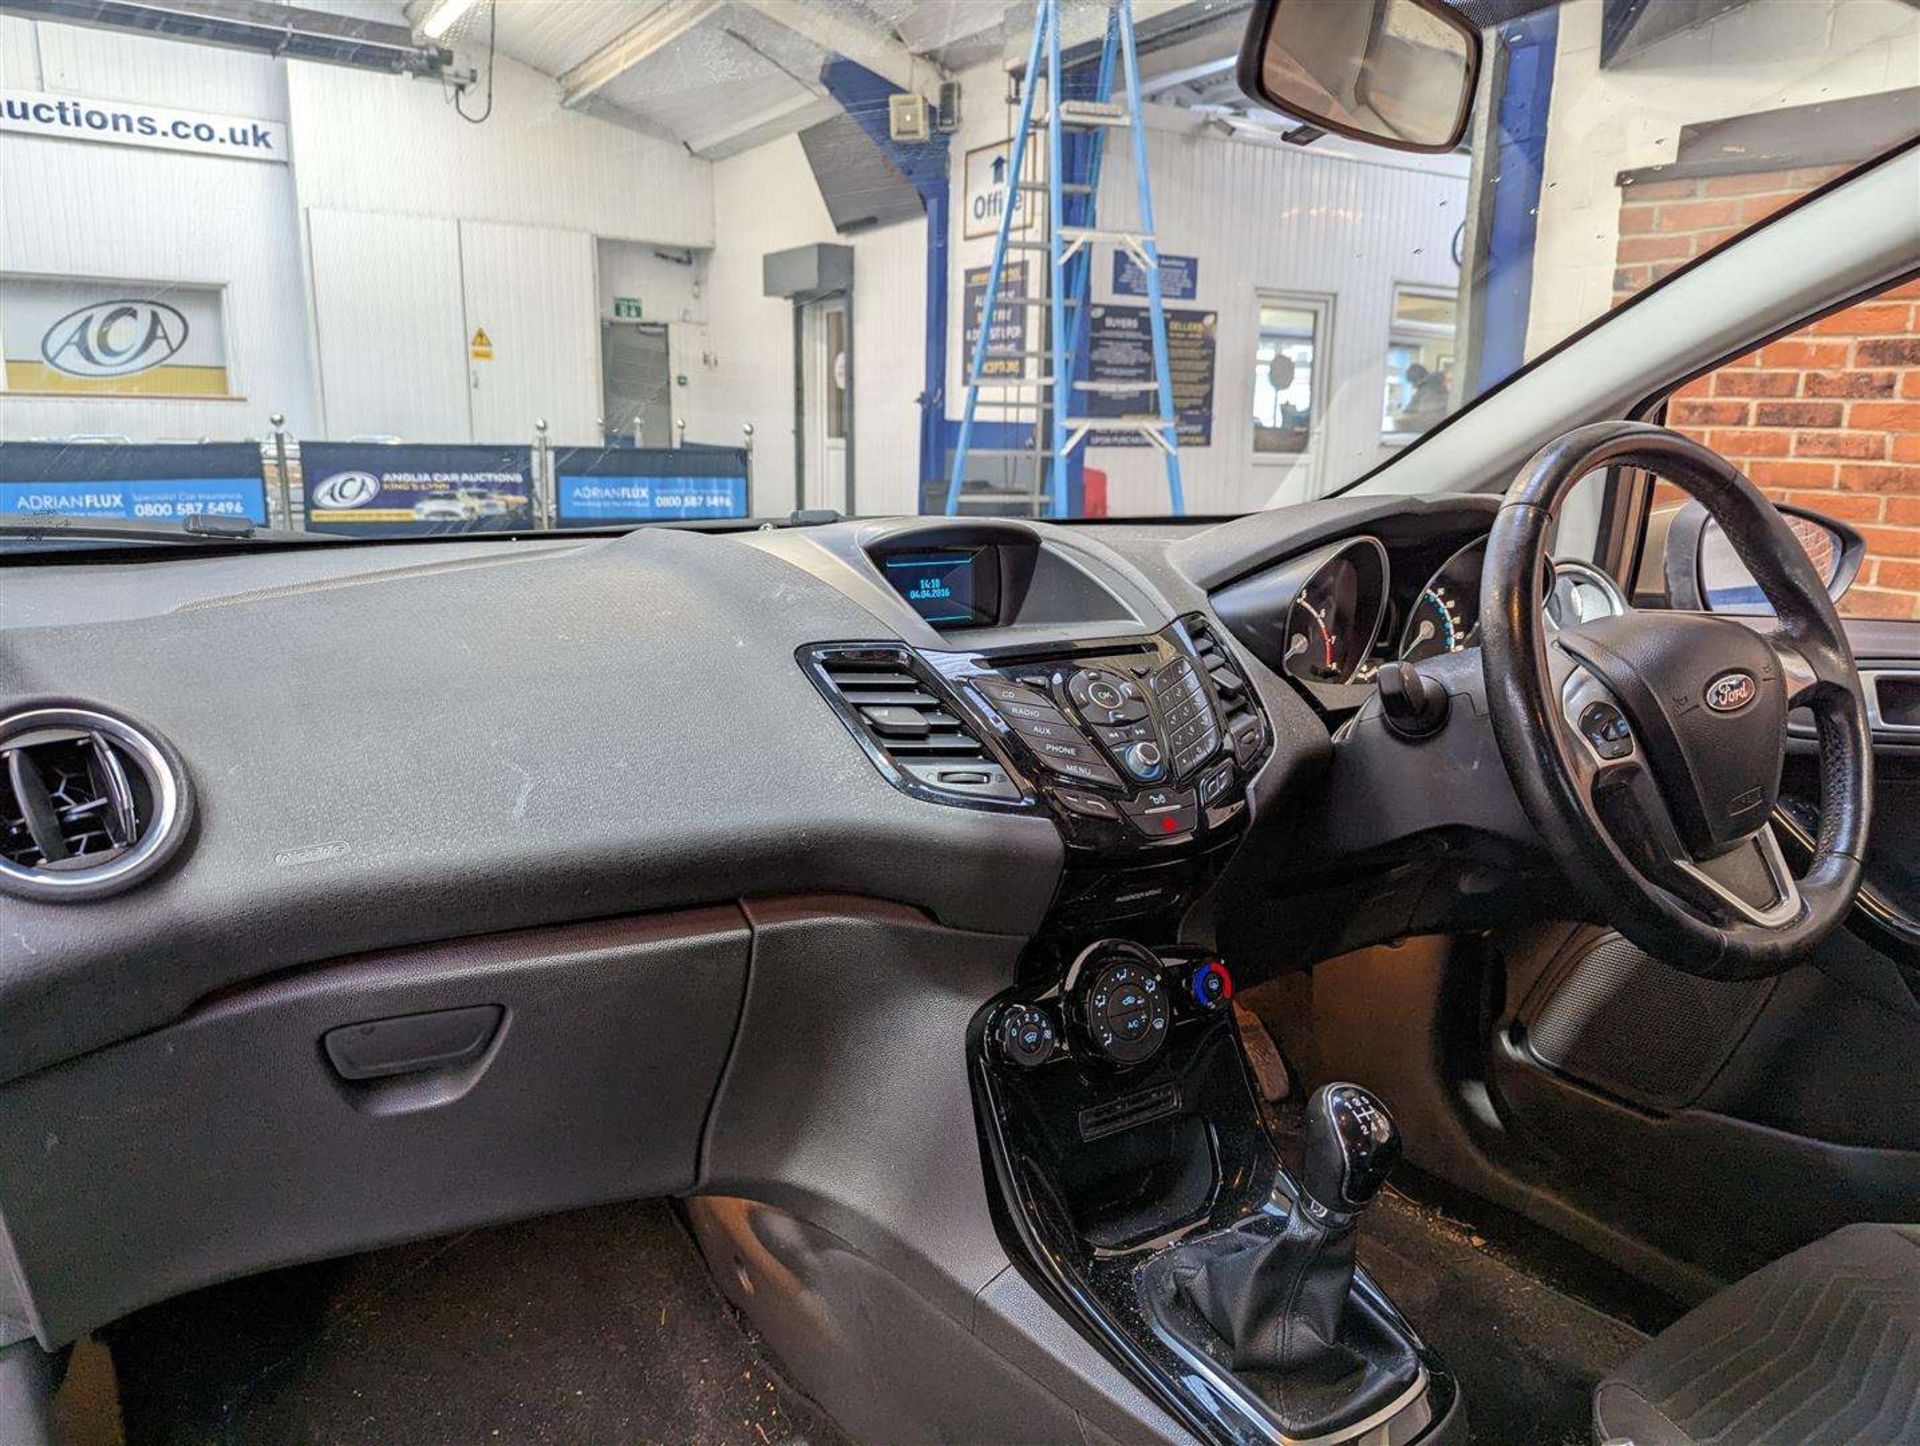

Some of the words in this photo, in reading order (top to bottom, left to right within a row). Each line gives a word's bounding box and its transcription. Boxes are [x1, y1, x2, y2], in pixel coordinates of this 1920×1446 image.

[49, 306, 178, 368] ACA
[382, 473, 431, 482] ANGLIA
[433, 473, 459, 482] CAR
[461, 472, 523, 483] AUCTIONS
[325, 477, 374, 503] ACA
[135, 503, 172, 517] 0800
[177, 502, 203, 516] 587
[207, 501, 244, 514] 5496
[1002, 690, 1015, 699] CD
[1097, 691, 1113, 700] OK
[1718, 680, 1748, 706] Ford
[1011, 707, 1040, 718] RADIO
[1033, 726, 1051, 735] AUX
[1046, 743, 1076, 756] PHONE
[1066, 764, 1091, 776] MENU
[1344, 1101, 1352, 1109] 1
[1360, 1124, 1370, 1135] 2
